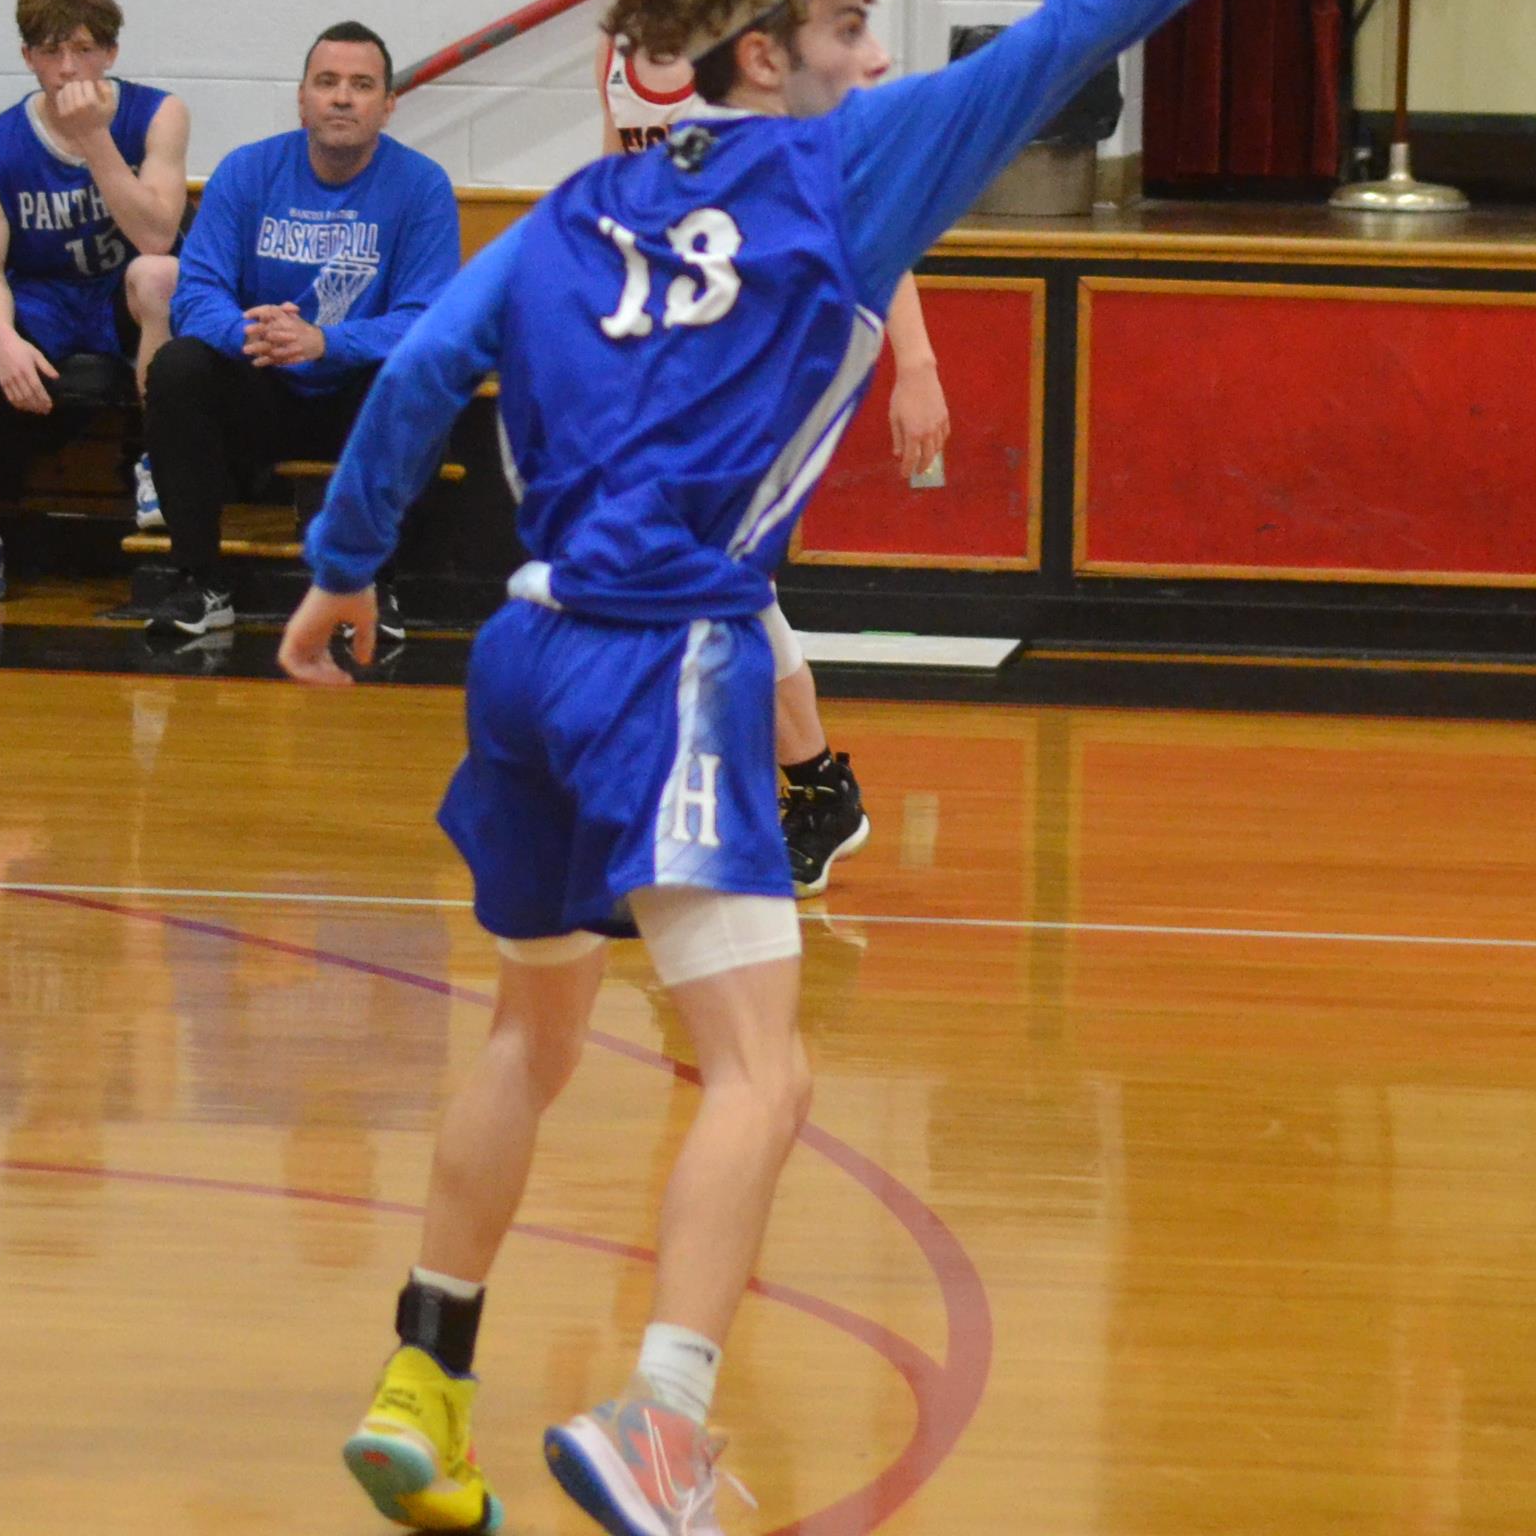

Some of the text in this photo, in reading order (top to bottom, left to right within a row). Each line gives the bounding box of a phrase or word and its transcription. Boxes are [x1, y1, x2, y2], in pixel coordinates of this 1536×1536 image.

[65, 227, 126, 276] 15
[598, 207, 742, 339] 13
[672, 752, 721, 846] H
